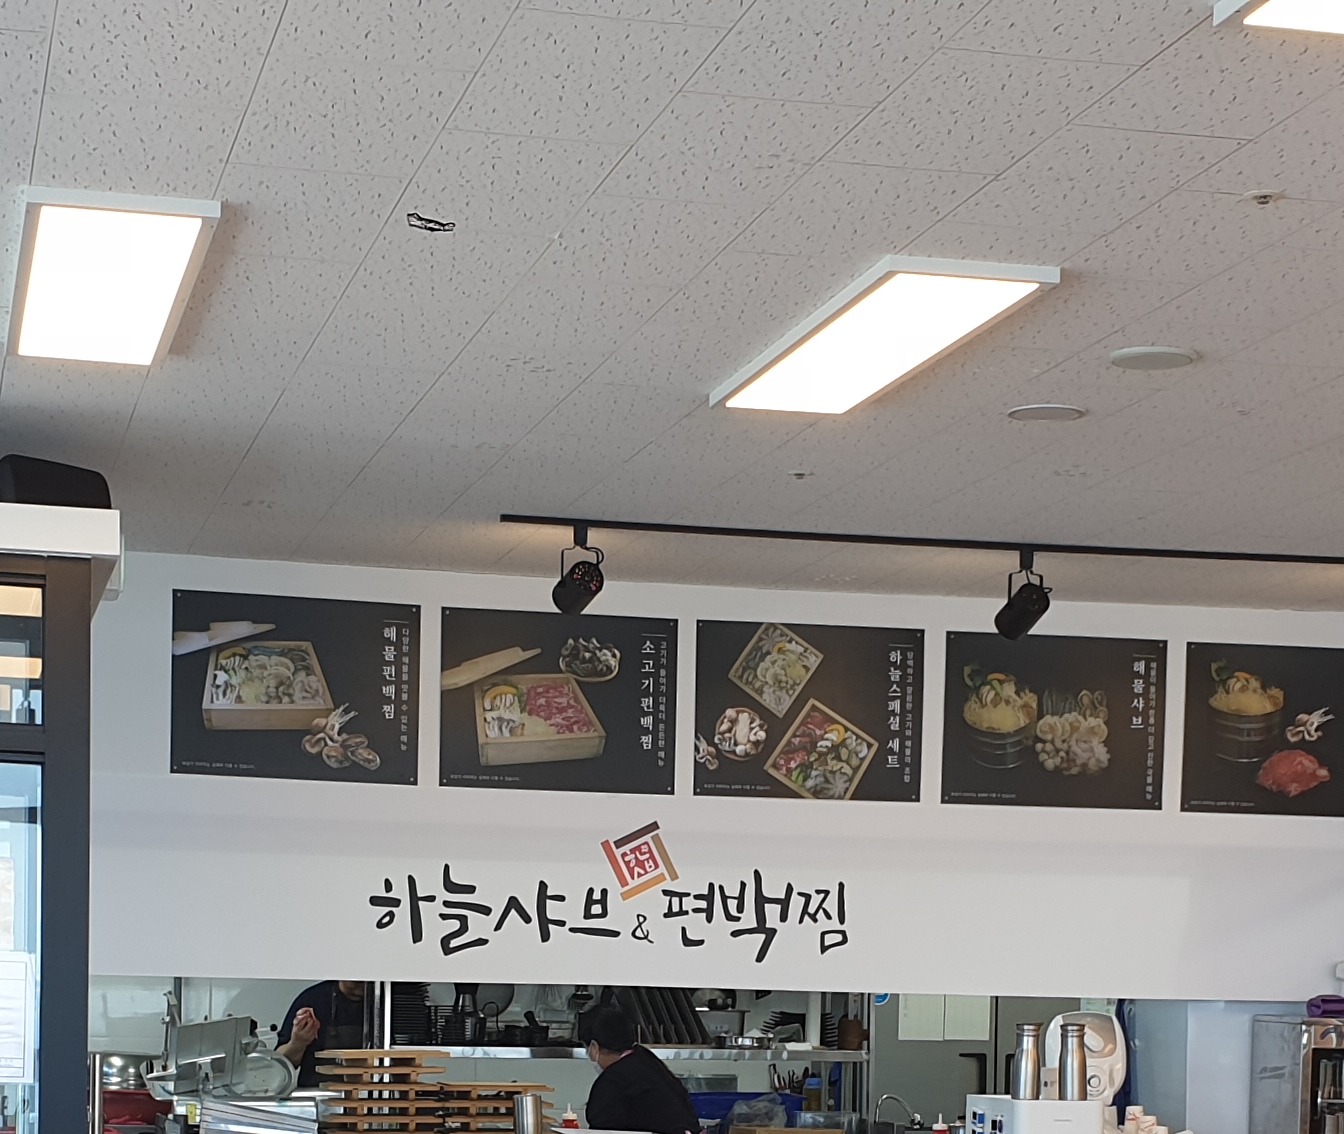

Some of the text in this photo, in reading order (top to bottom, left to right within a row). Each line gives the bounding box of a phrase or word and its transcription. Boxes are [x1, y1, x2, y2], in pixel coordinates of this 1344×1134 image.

[381, 626, 397, 720] 해물편백찜
[640, 640, 656, 750] 소고기편백찜
[886, 650, 902, 768] 하늘스페셜 세트
[1131, 660, 1145, 729] 해물샤브
[368, 863, 849, 964] 하늘샤브 & 편백찜
